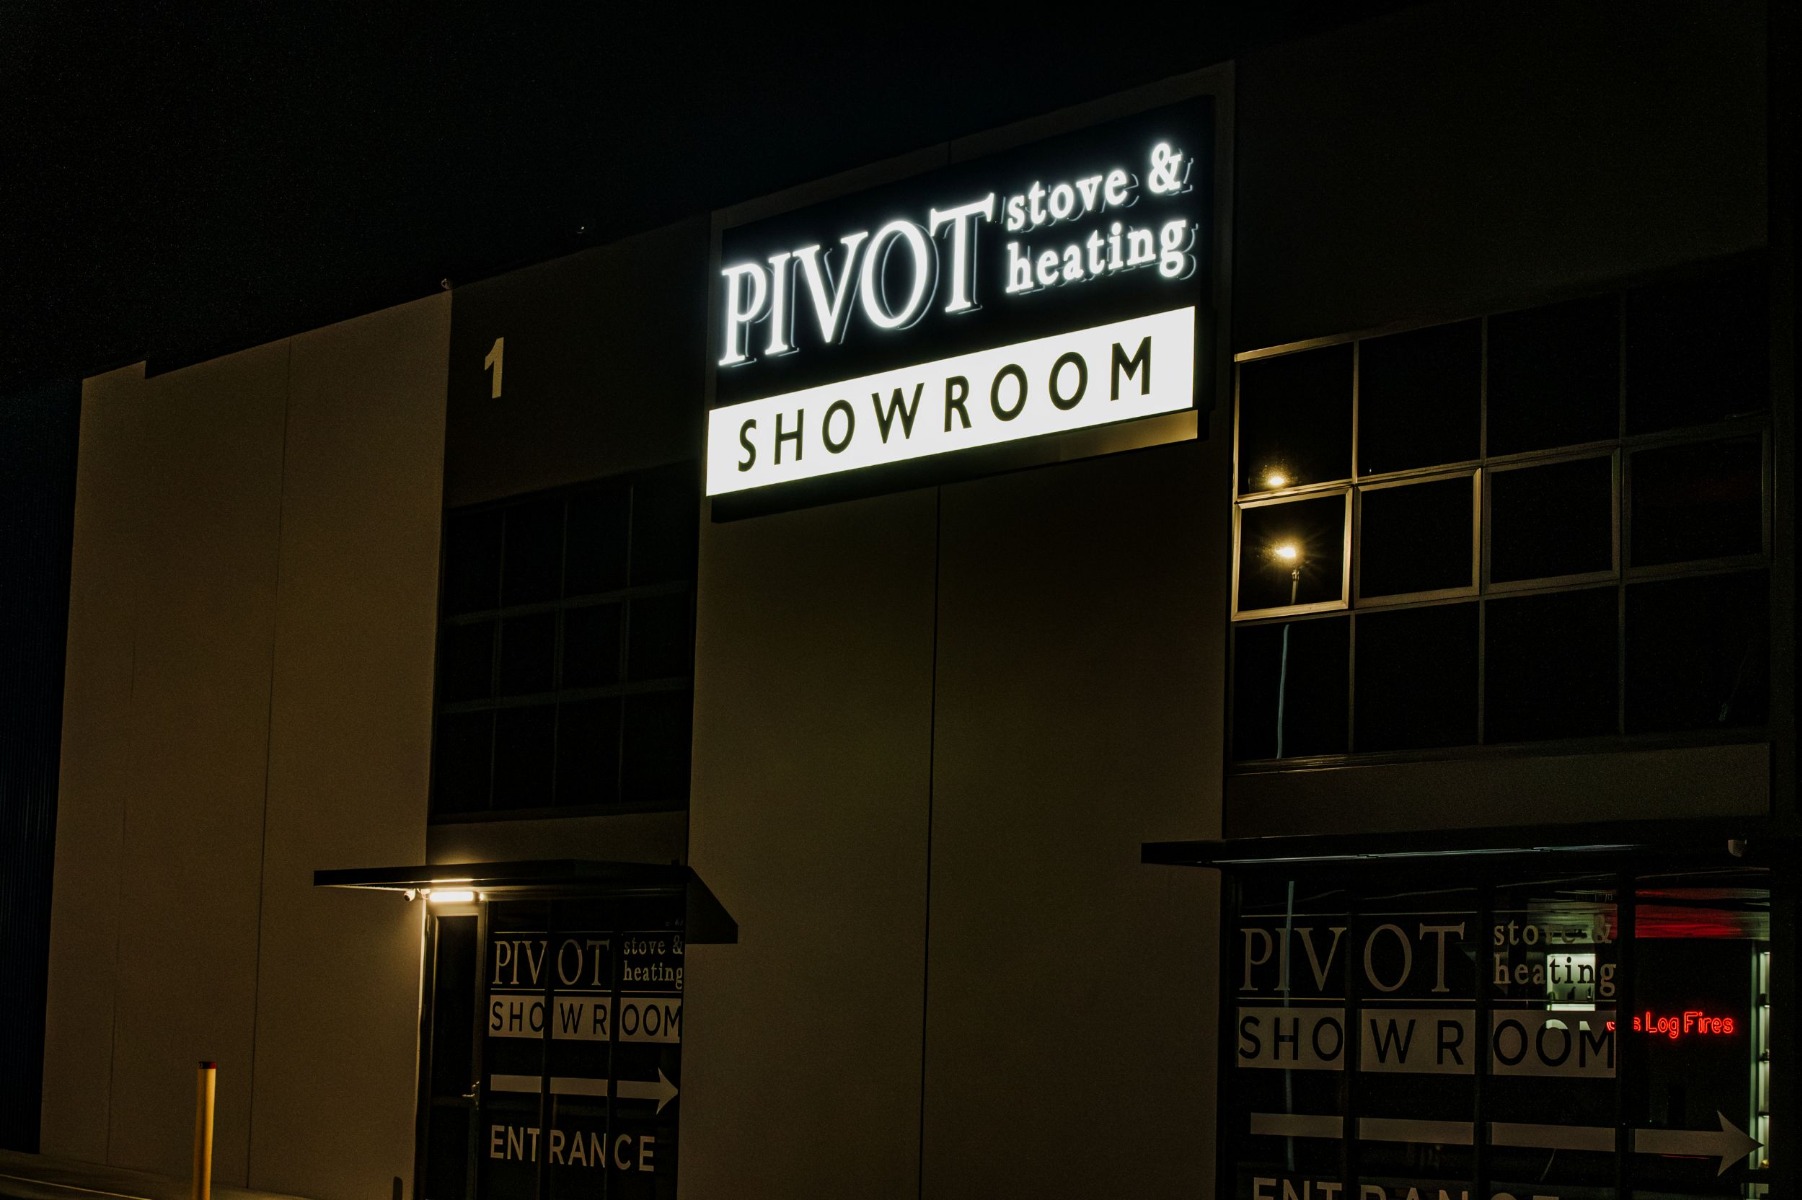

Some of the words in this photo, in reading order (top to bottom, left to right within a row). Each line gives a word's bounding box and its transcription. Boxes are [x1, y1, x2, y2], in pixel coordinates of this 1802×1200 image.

[1006, 167, 1129, 232] stove
[1148, 142, 1183, 195] &
[717, 192, 996, 367] PIVOT
[1005, 218, 1188, 295] heating
[484, 336, 505, 400] 1
[738, 336, 1152, 472] SHOWROOM
[491, 938, 611, 987] PIVOT
[623, 936, 666, 956] stove
[672, 934, 684, 956] &
[1239, 921, 1466, 993] PIVOT
[623, 960, 684, 991] heating
[1493, 952, 1617, 998] heating
[491, 1001, 681, 1037] SHOWROOM
[1239, 1015, 1615, 1069] SHOWROOM
[1645, 1011, 1680, 1039] Log
[1683, 1011, 1734, 1034] Fires
[489, 1124, 657, 1173] ENTRANCE
